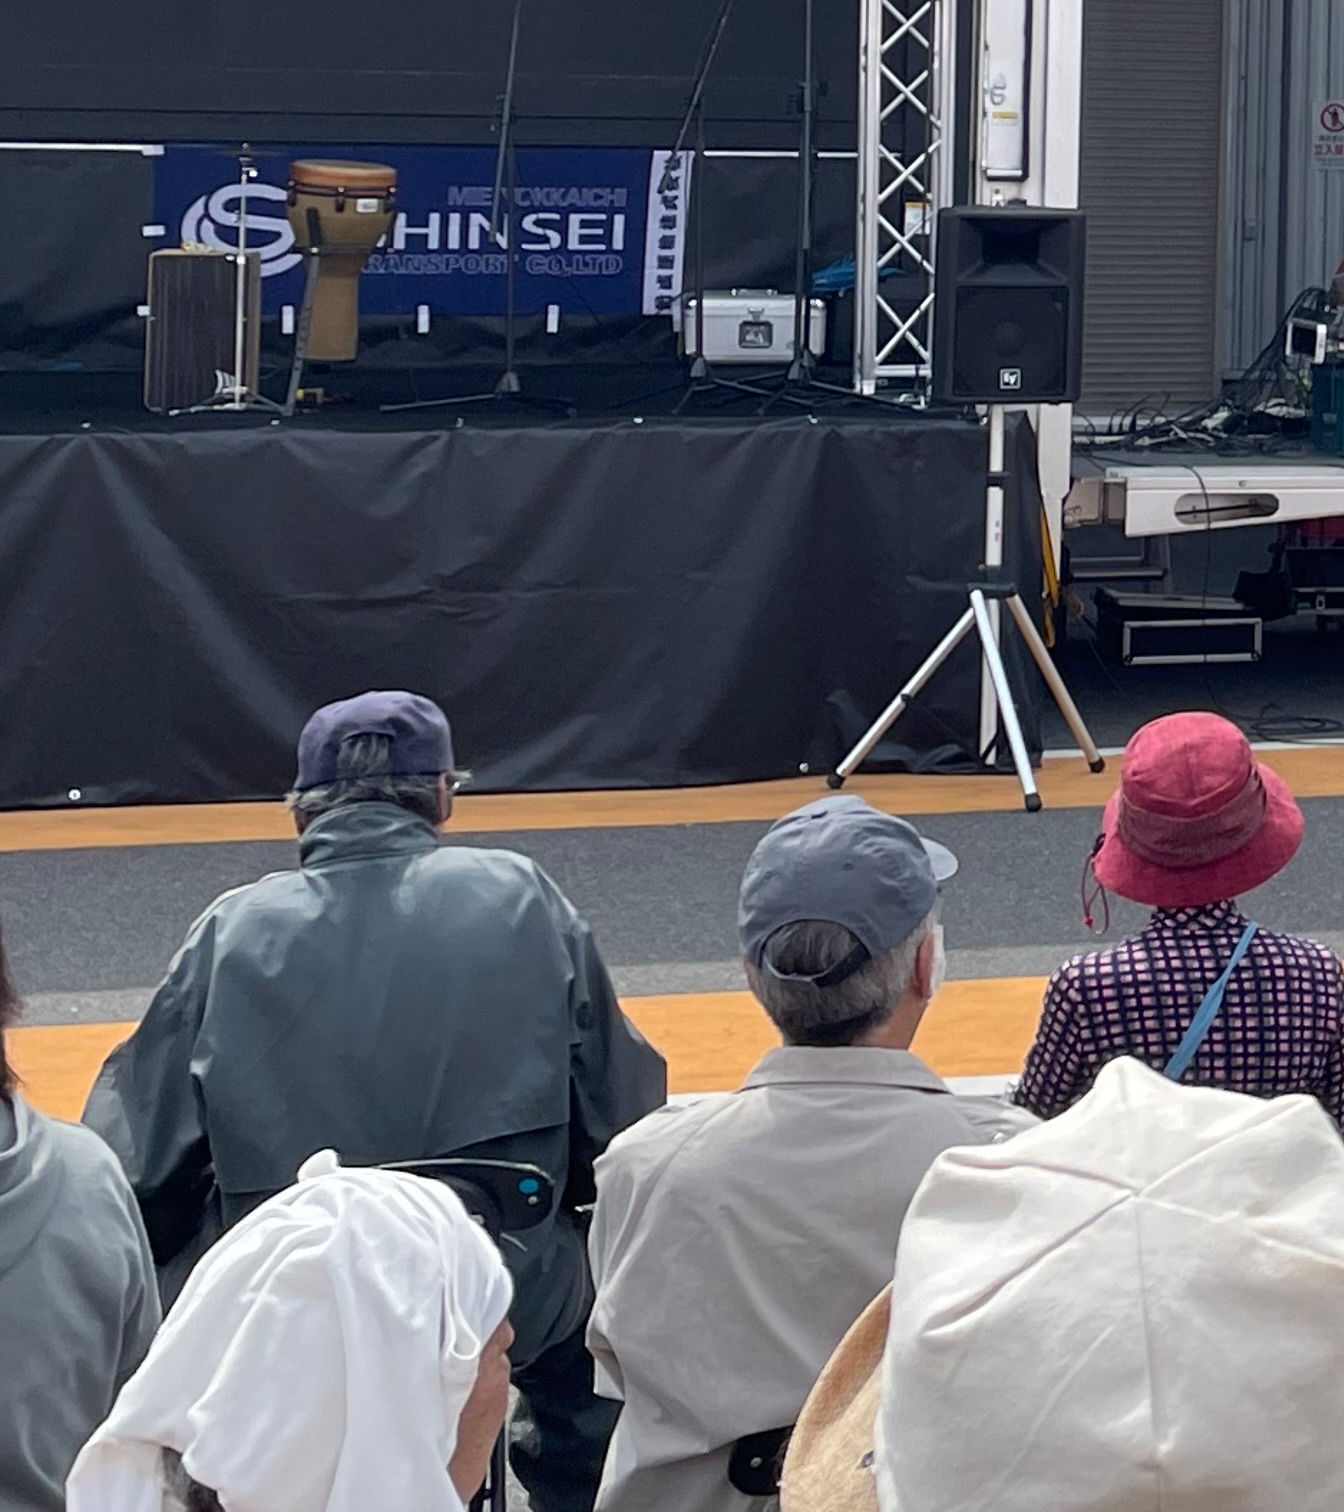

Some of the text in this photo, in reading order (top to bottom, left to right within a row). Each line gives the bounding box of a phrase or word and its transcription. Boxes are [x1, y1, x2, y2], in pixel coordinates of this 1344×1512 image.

[447, 186, 492, 207] MIE
[376, 212, 625, 251] HINSEI
[363, 254, 519, 275] RANSPORT
